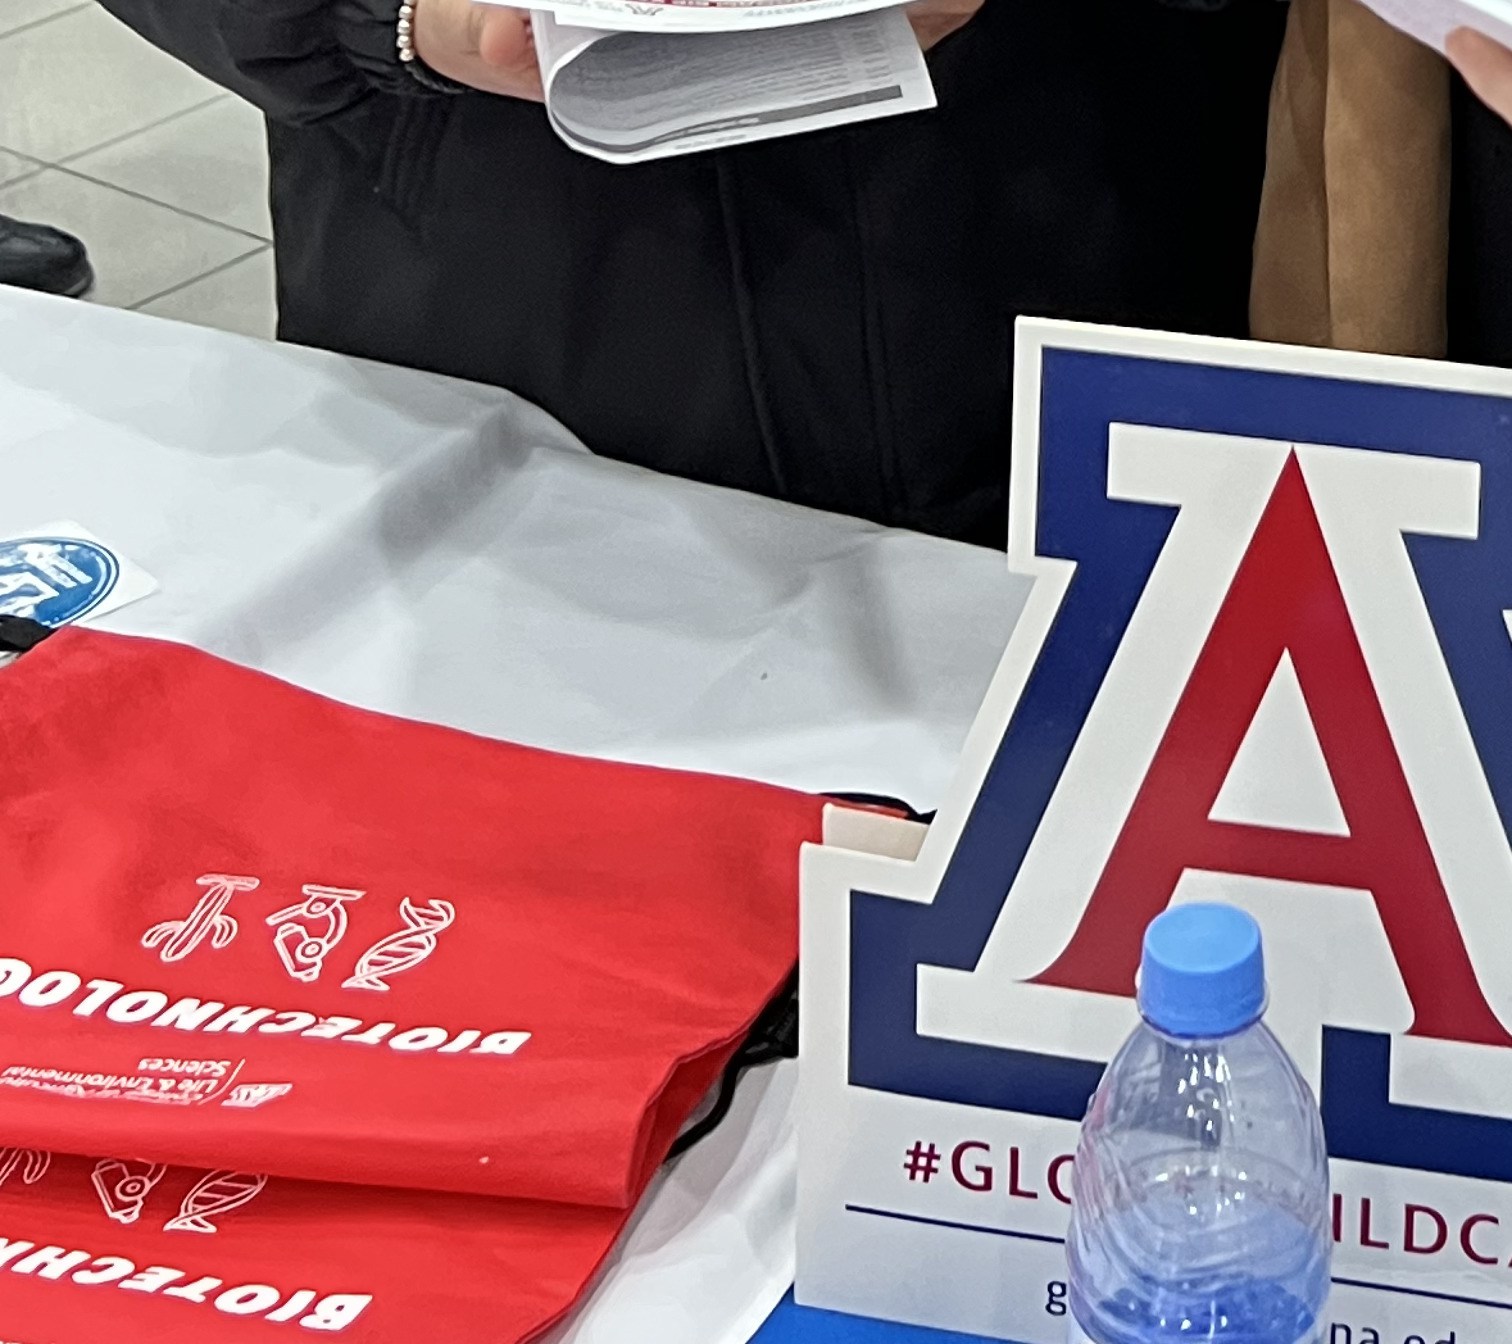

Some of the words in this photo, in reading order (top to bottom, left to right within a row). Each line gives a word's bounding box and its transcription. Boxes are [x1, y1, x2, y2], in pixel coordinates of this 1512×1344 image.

[1, 1065, 153, 1092] Environmental
[137, 1057, 232, 1077] Sciences
[903, 1139, 1076, 1206] #GLO
